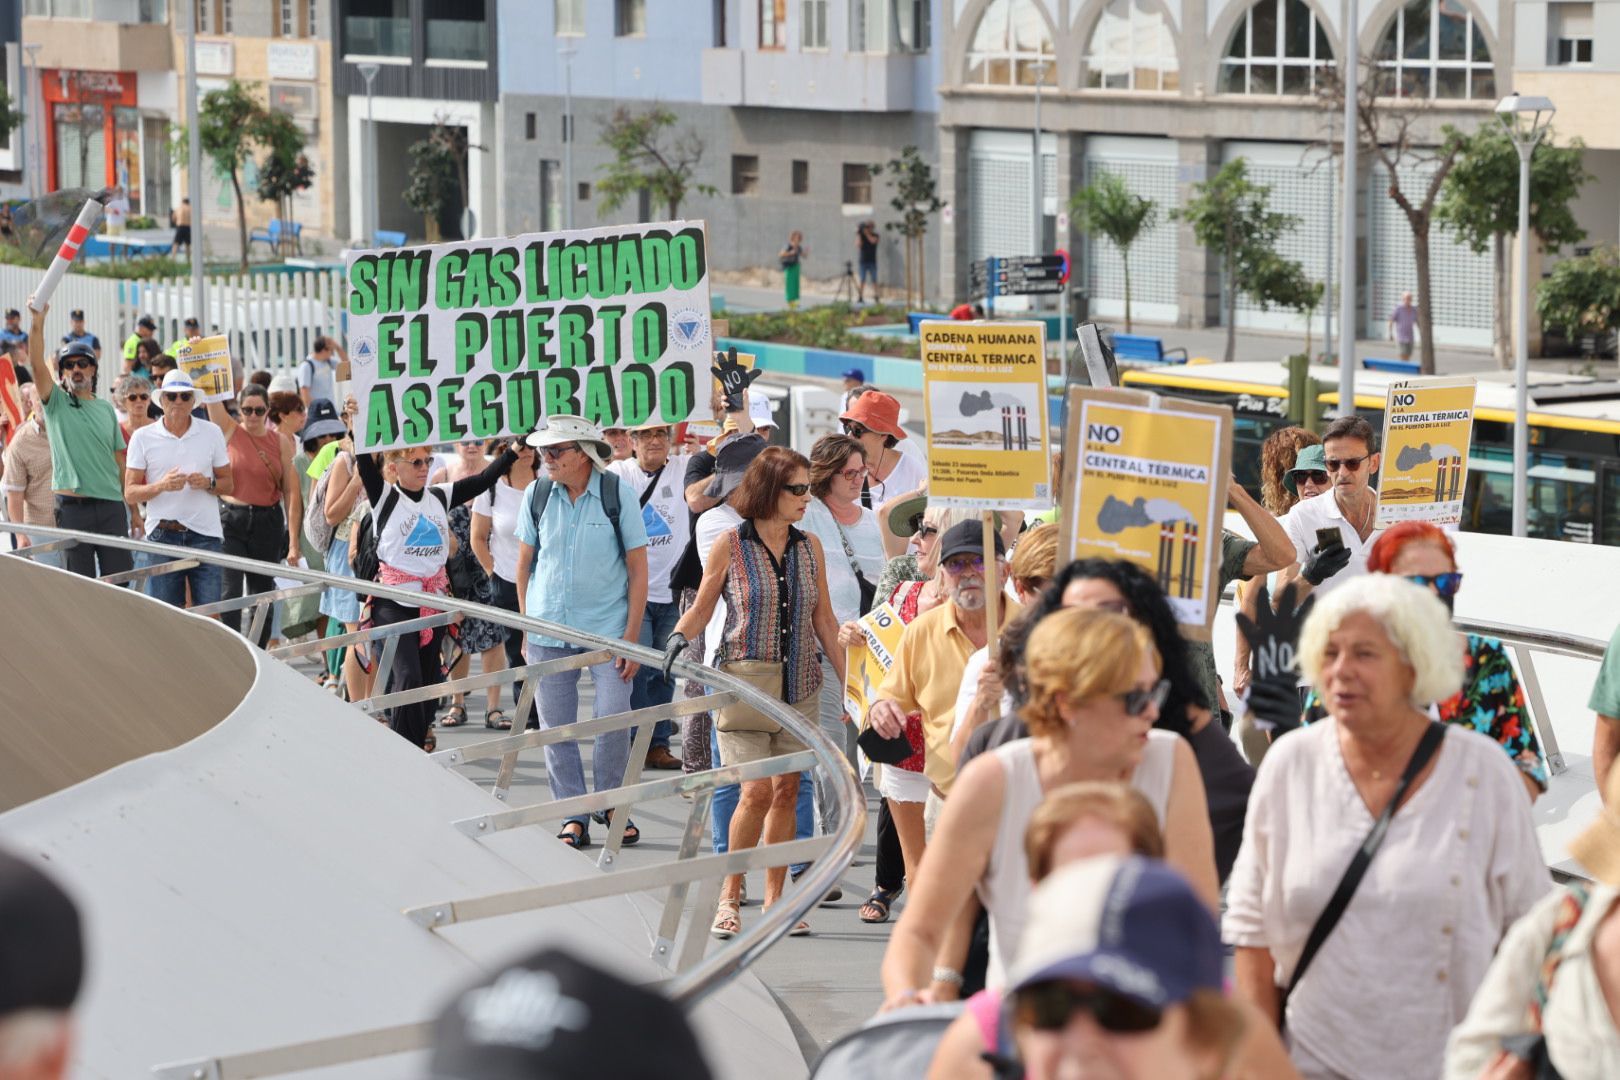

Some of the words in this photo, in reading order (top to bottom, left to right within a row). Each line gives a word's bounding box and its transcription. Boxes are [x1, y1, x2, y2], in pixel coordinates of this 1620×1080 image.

[350, 250, 431, 315] SIN
[435, 247, 521, 310] GAS
[525, 228, 705, 303] LICUADO
[378, 314, 437, 379] EL
[455, 302, 668, 375] PUERTO
[925, 332, 974, 344] CADENA
[978, 334, 1036, 345] HUMANA
[926, 352, 978, 364] CENTRAL
[723, 370, 741, 395] NO
[365, 361, 695, 447] ASEGURADO
[1393, 393, 1415, 407] NO
[1391, 413, 1430, 424] CENTRAL
[1088, 424, 1120, 443] NO
[1086, 454, 1143, 473] CENTRAL
[404, 545, 444, 557] SALVAR
[873, 608, 892, 628] NO
[1258, 634, 1295, 680] NO
